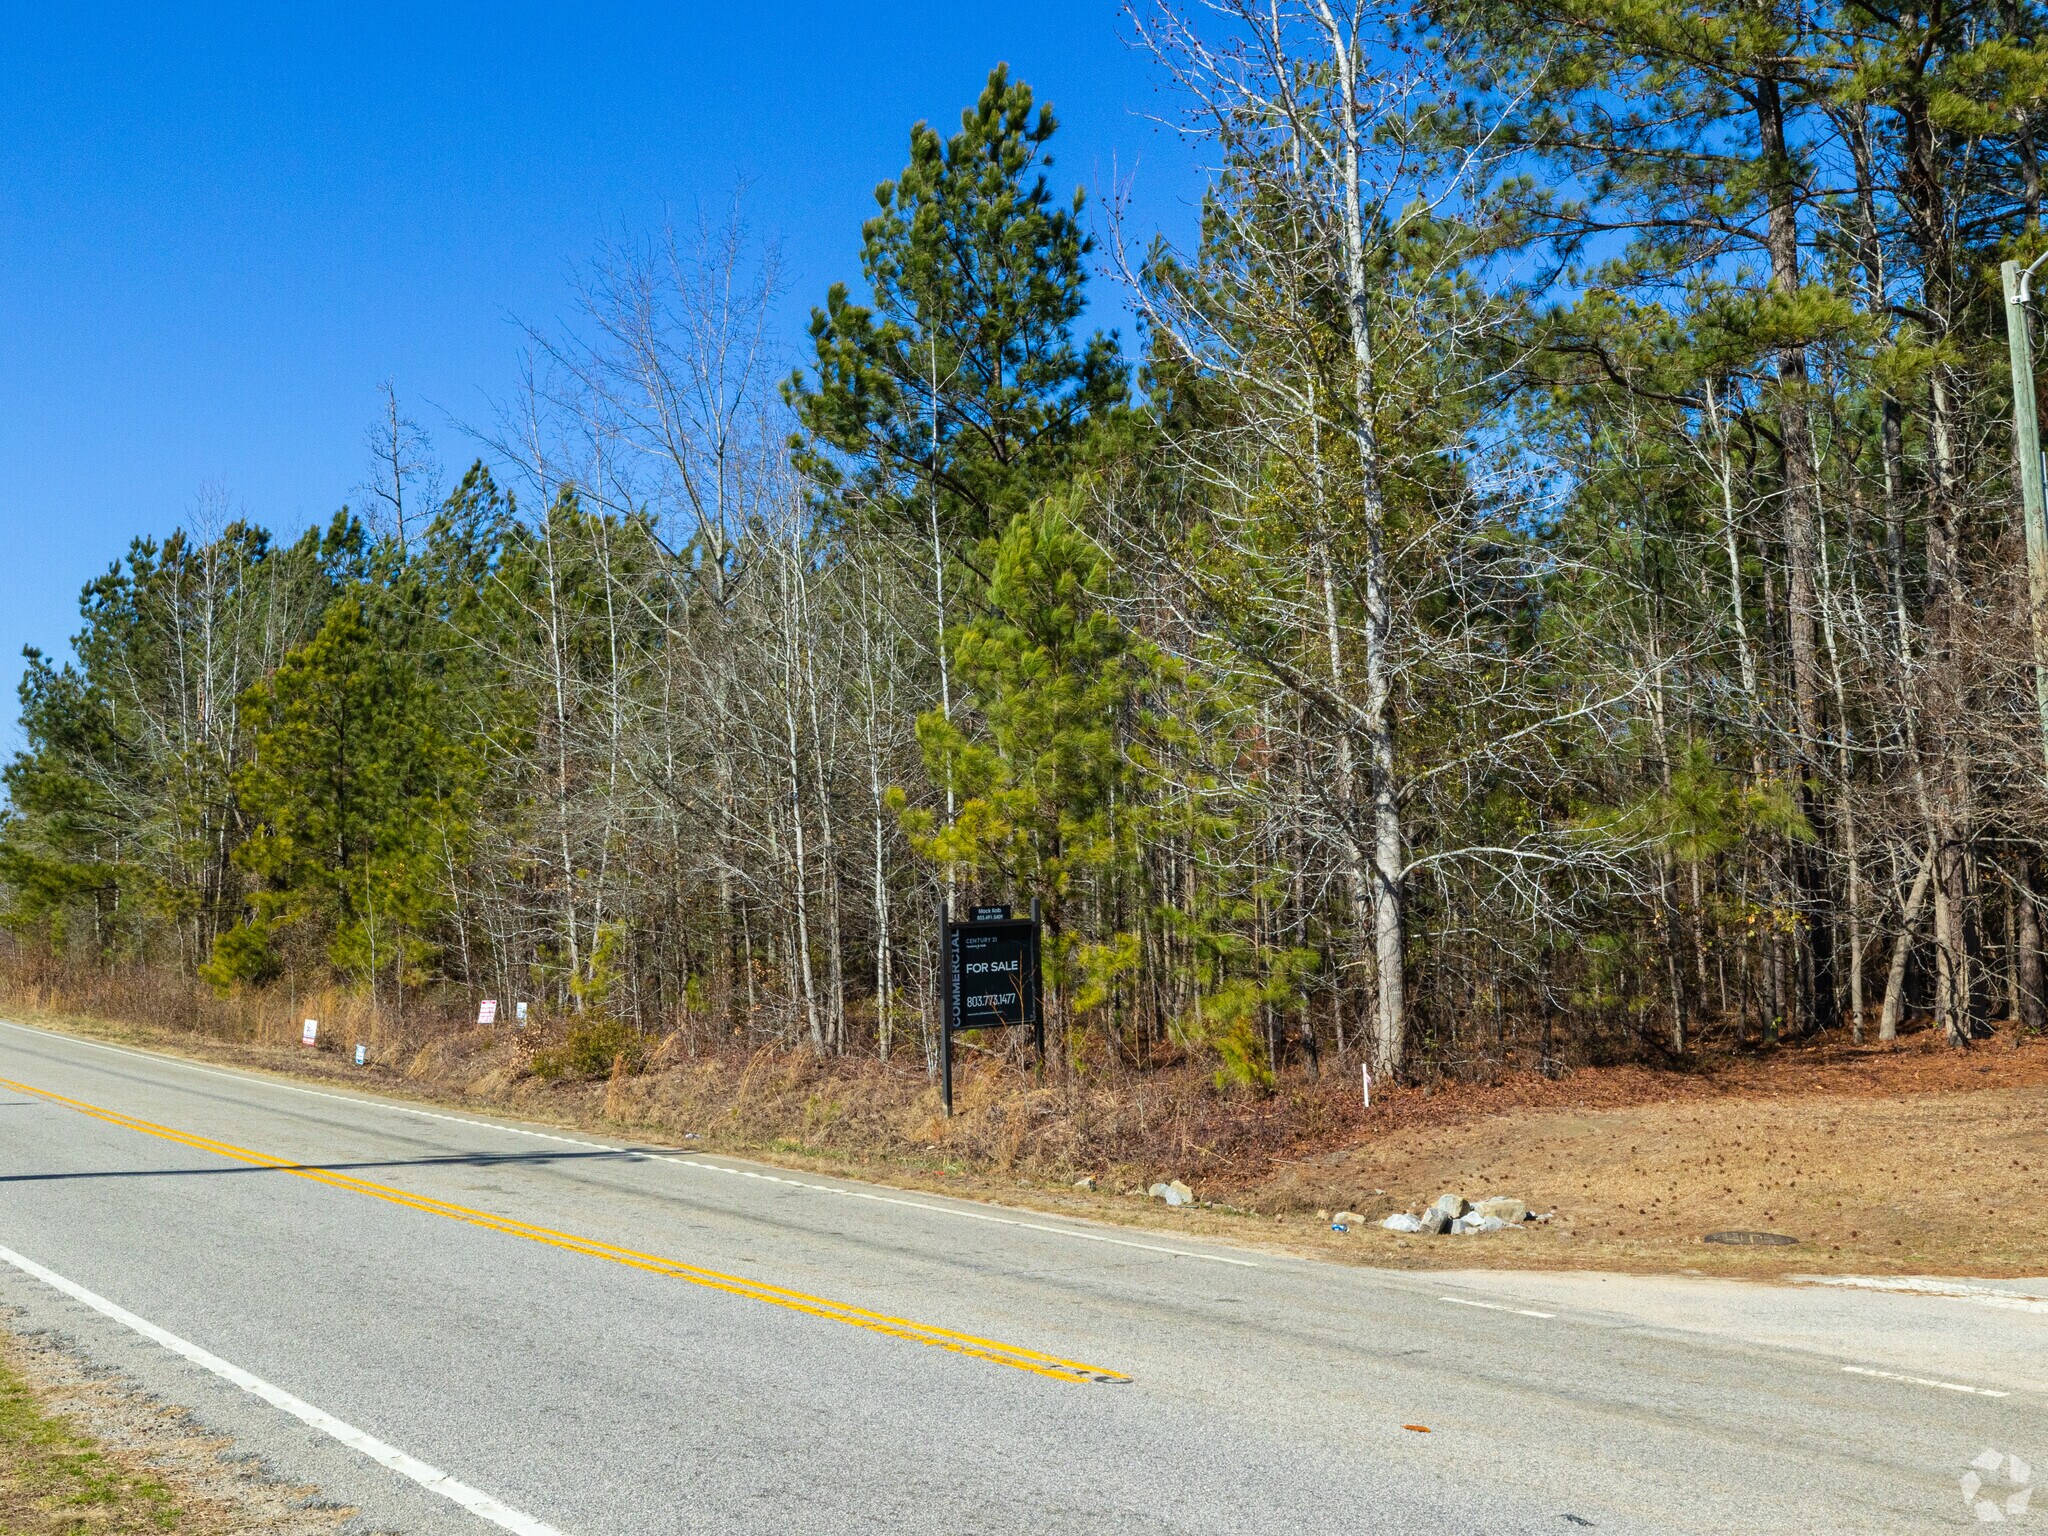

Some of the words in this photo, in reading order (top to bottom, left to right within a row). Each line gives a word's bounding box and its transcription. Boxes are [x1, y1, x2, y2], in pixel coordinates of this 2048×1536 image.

[965, 937, 991, 945] CENTURY
[966, 962, 989, 974] FOR
[990, 960, 1019, 972] SALE
[951, 929, 961, 1028] COMMERCIAL
[966, 992, 1016, 1008] 803.773.1477
